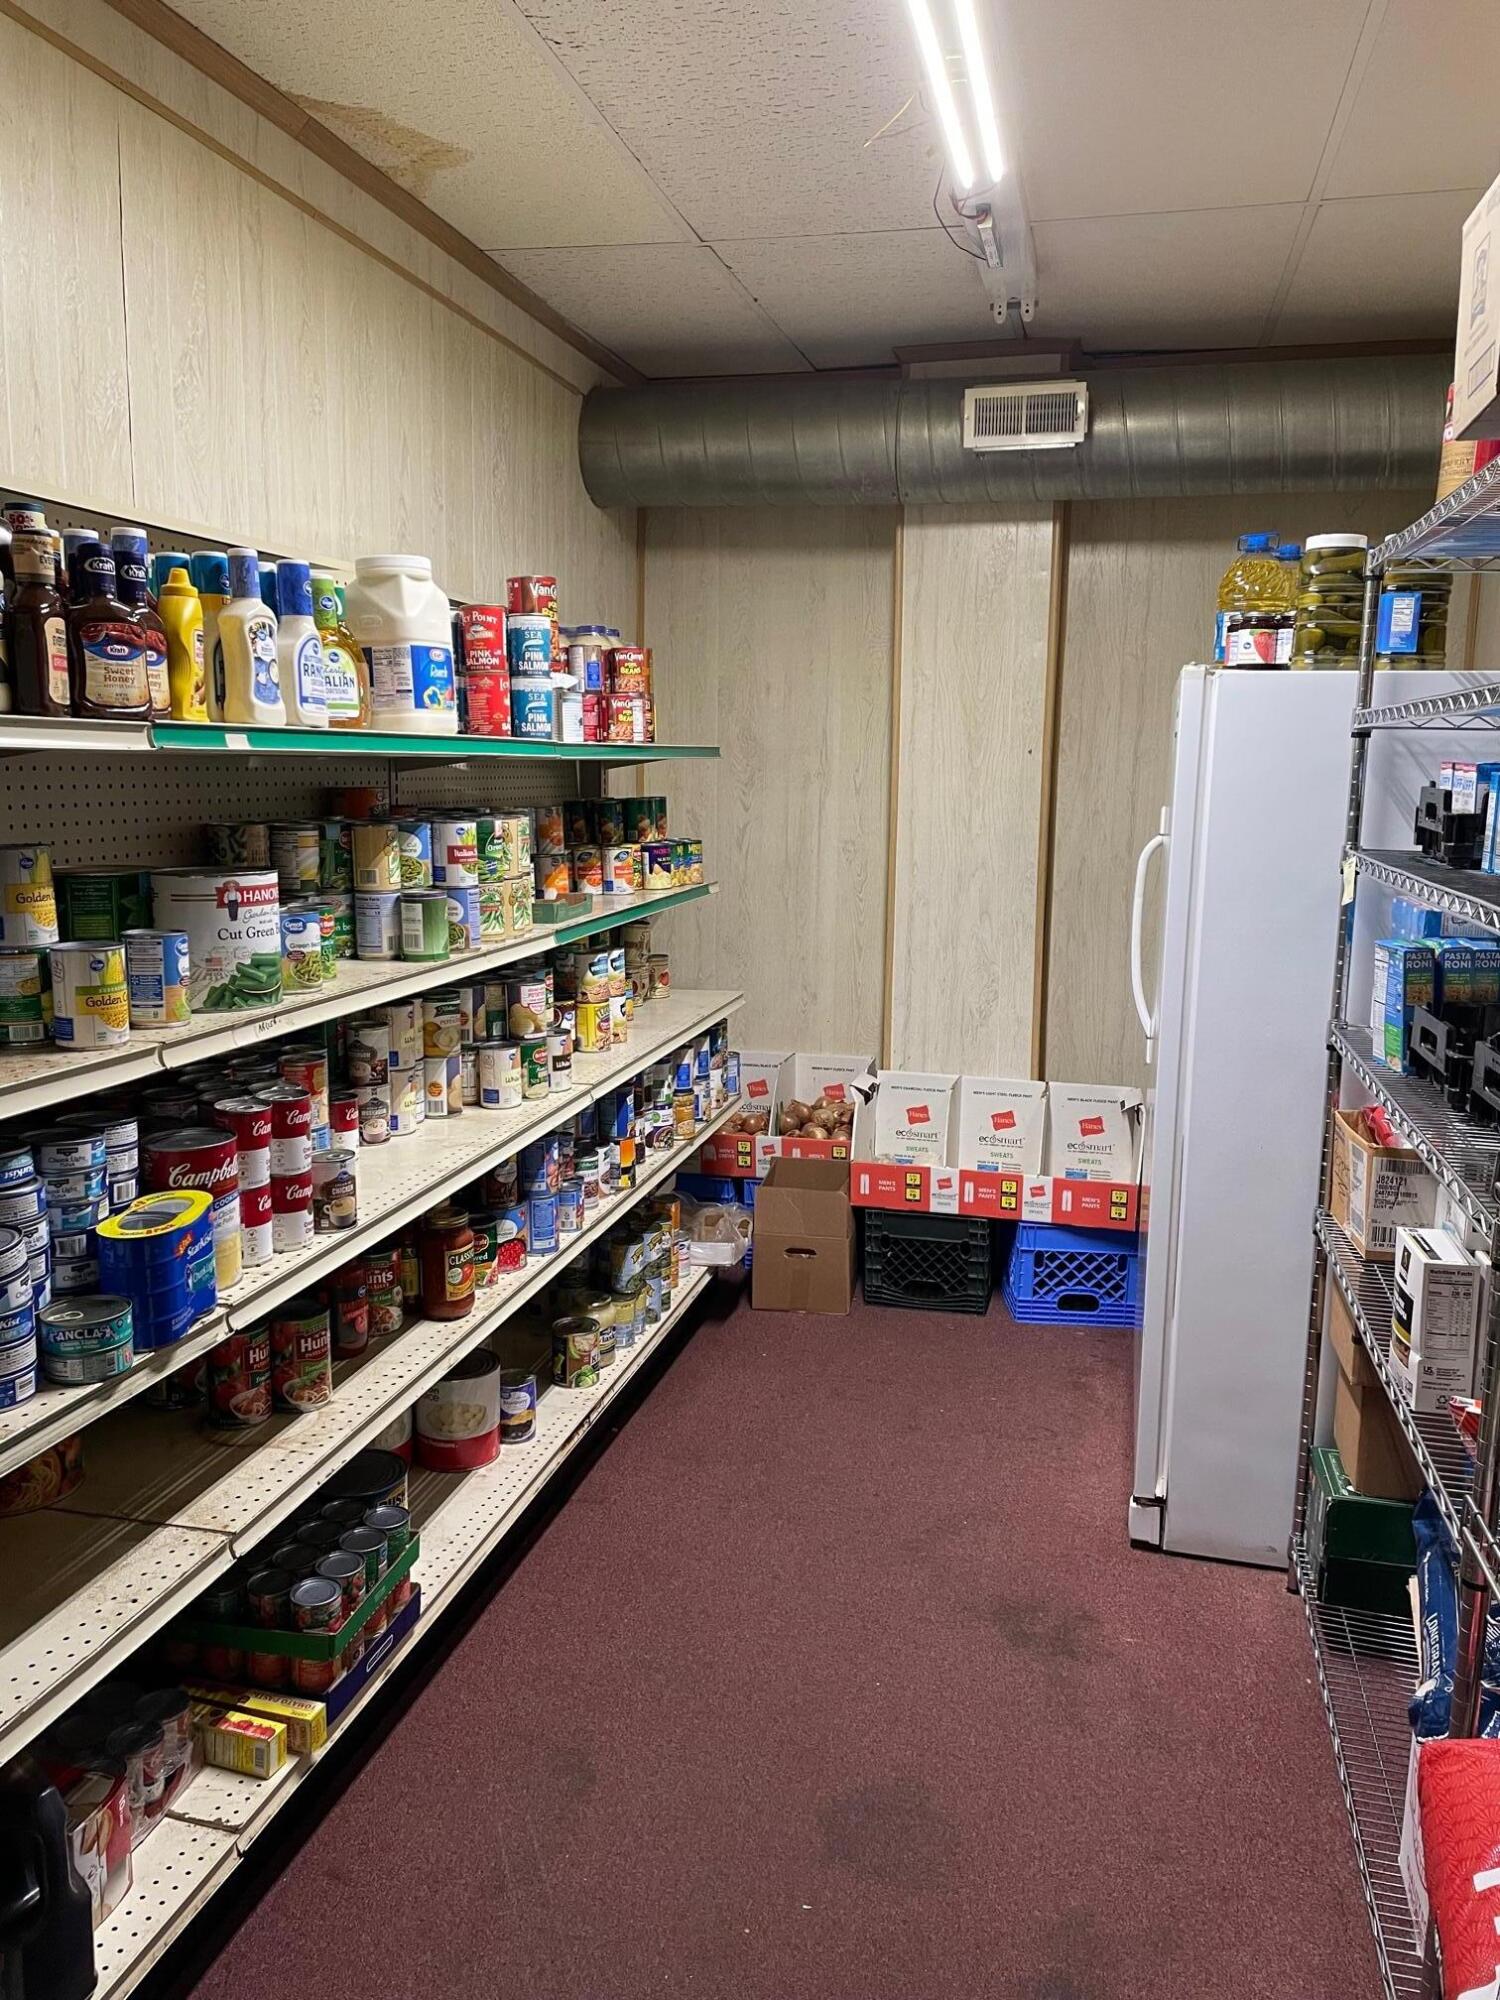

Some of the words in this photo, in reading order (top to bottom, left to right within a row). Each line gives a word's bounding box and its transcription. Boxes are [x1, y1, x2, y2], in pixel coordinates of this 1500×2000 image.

[472, 610, 498, 625] POINT
[109, 646, 126, 654] Kraft
[469, 649, 492, 658] PINK
[524, 651, 544, 661] PINK
[104, 667, 134, 676] Sweet
[104, 675, 135, 684] Honey
[528, 693, 545, 701] SEA
[527, 713, 547, 723] PINK
[16, 891, 52, 904] Golden
[217, 927, 243, 941] Cut
[246, 926, 275, 939] Green
[1406, 952, 1433, 960] PASTA
[1444, 952, 1472, 960] PASTA
[1475, 951, 1500, 960] PASTA
[1406, 960, 1433, 969] RONI
[1444, 960, 1472, 969] RONI
[1474, 960, 1500, 969] RONI
[85, 994, 122, 1008] Golden
[994, 1116, 1014, 1125] Hanes
[895, 1129, 938, 1139] ecosmart
[978, 1135, 1023, 1146] ecosmart
[905, 1145, 929, 1153] SWEATS
[1066, 1141, 1112, 1152] ecosmart
[990, 1151, 1014, 1160] SWEATS
[1457, 1269, 1473, 1278] Facts
[300, 1330, 328, 1353] Hun
[1426, 1612, 1441, 1647] LONG
